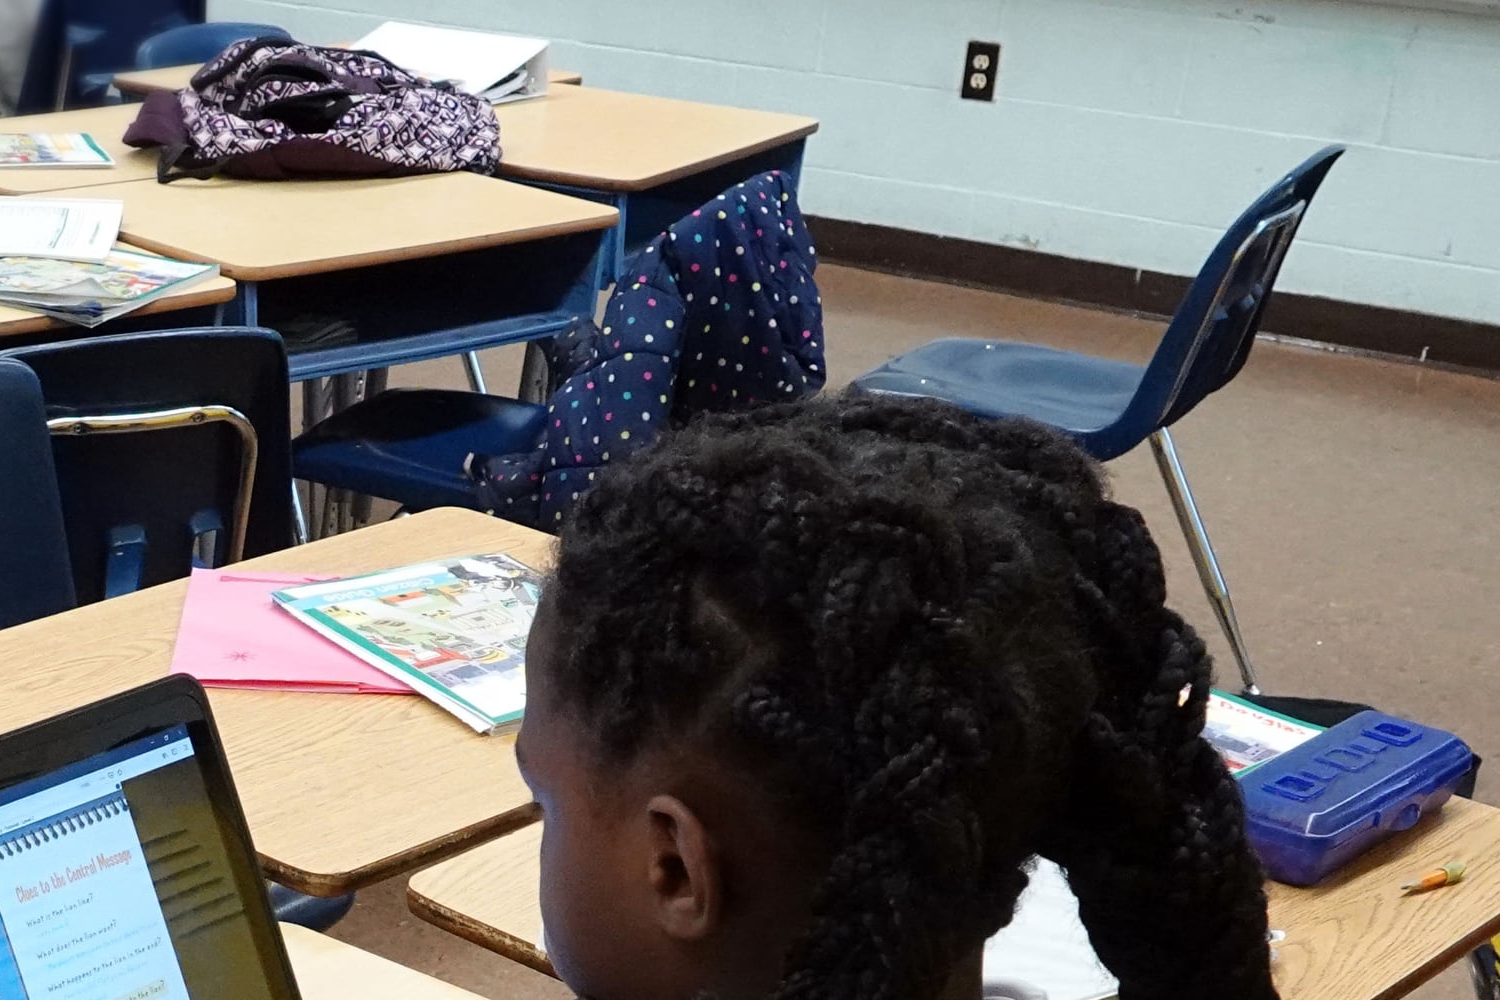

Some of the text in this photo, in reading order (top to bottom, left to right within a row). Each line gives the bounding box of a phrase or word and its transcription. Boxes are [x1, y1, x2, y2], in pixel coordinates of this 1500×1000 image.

[15, 848, 133, 904] Clues to the Central Message
[26, 914, 47, 928] What
[52, 905, 64, 917] the
[36, 948, 54, 960] What
[72, 934, 84, 945] the
[48, 980, 66, 992] What
[101, 959, 113, 969] the
[134, 946, 146, 956] the
[137, 990, 150, 1000] the
